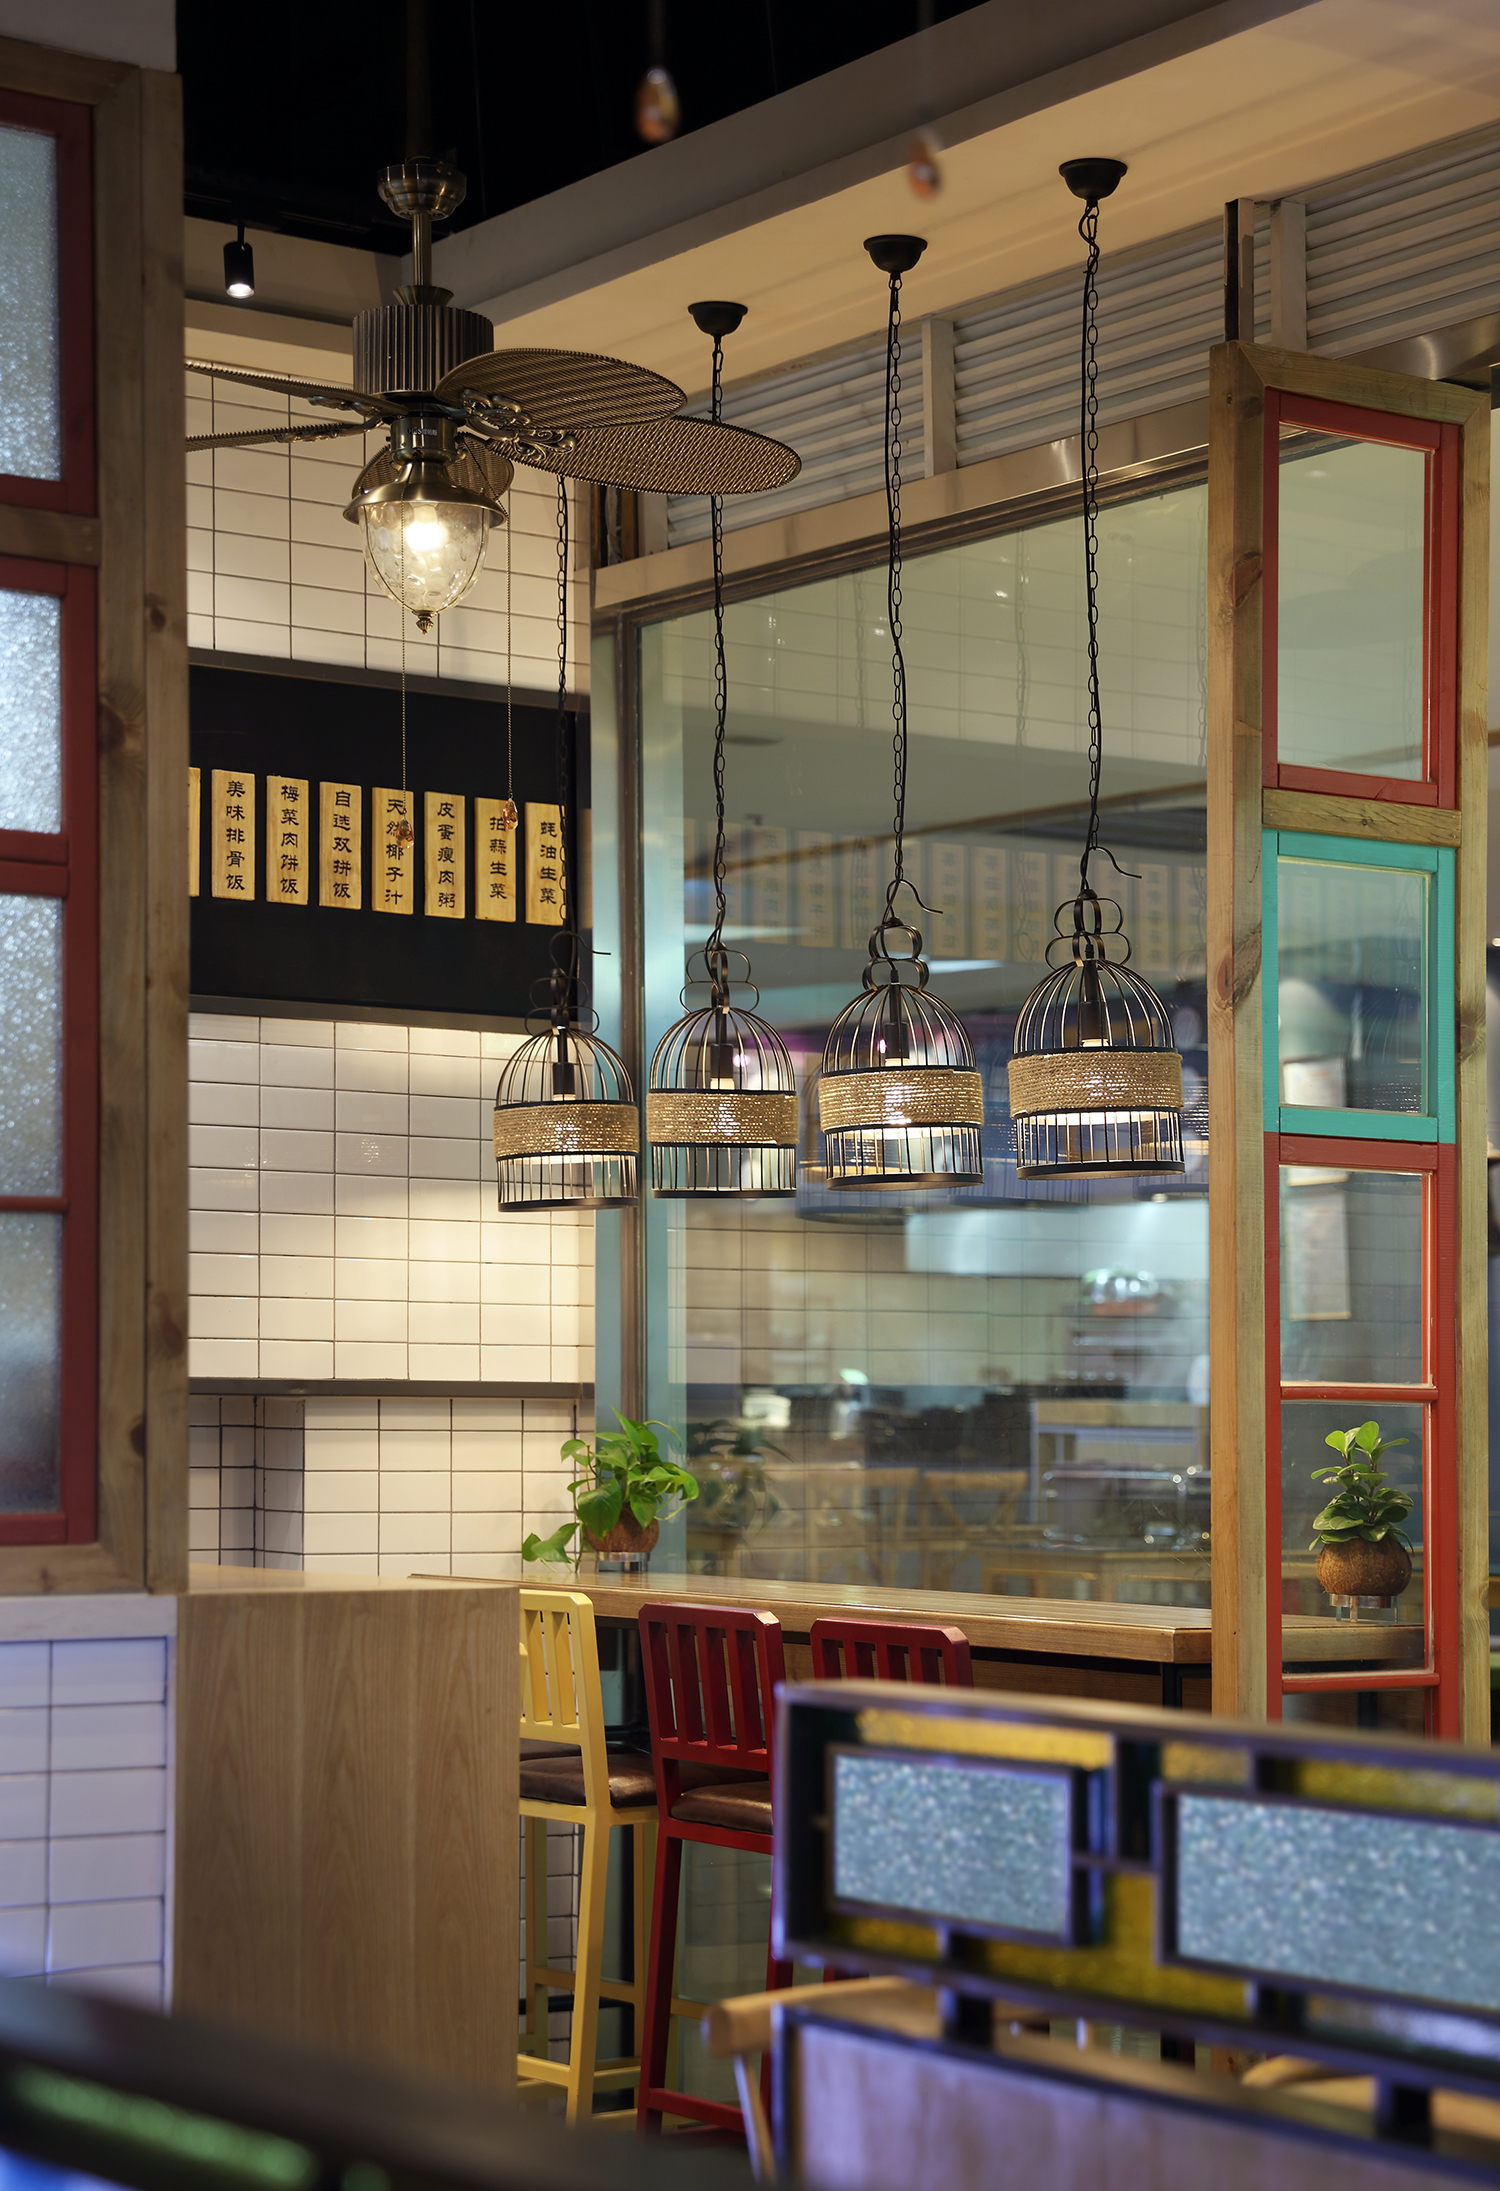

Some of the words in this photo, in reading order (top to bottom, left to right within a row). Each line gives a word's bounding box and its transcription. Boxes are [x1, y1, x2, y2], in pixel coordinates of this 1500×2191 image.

[226, 780, 246, 891] 美味排骨饭
[280, 785, 300, 894] 梅菜肉饼饭
[332, 790, 352, 899] 自选双拼饭
[437, 802, 456, 909] 皮蛋瘦肉粥
[539, 821, 557, 905] 蚝油生菜
